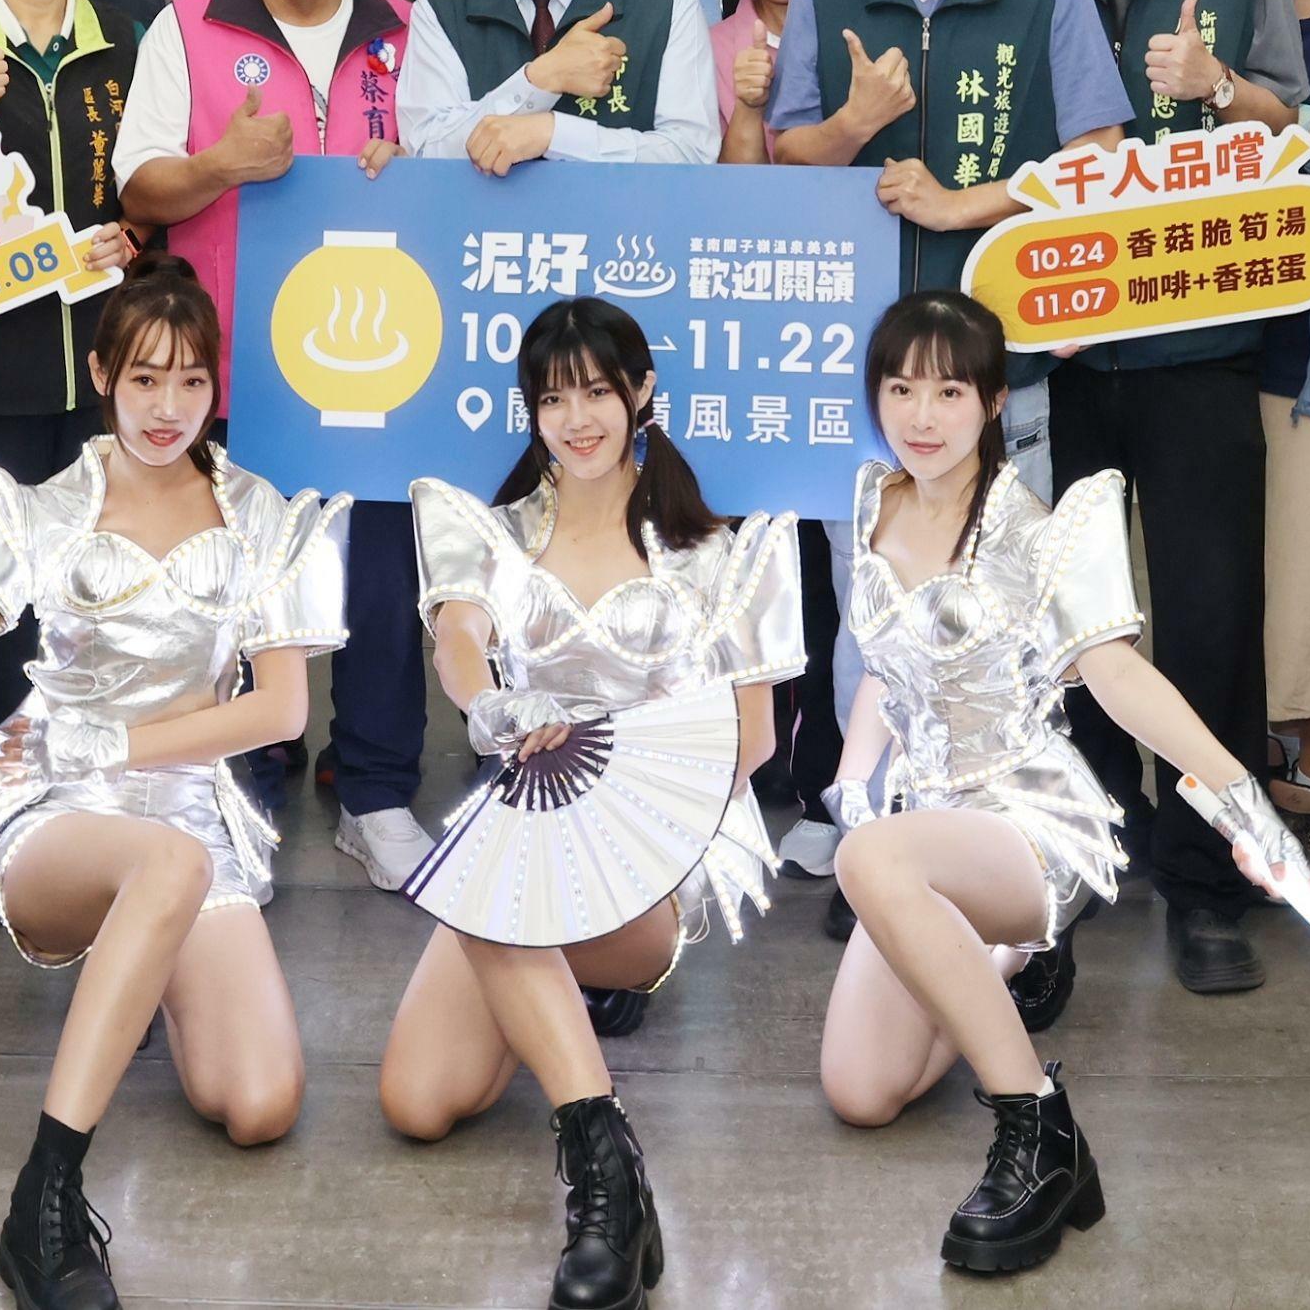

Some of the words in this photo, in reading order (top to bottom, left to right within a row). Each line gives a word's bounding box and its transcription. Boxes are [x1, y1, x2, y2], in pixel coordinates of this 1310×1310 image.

[105, 79, 124, 131] 白河
[359, 71, 389, 140] 蔡育
[953, 68, 990, 189] 林國華
[988, 42, 1017, 180] 觀光旅遊局局
[1055, 131, 1264, 205] 千人品嚐
[462, 231, 588, 295] 泥好
[604, 260, 666, 283] 2026
[690, 237, 854, 256] 臺南關子嶺溫泉美食節
[1029, 240, 1106, 273] 10.24
[1126, 206, 1306, 260] 香菇脆筍湯
[688, 257, 855, 303] 歡迎關嶺
[1034, 287, 1106, 318] 11.07
[1128, 253, 1307, 305] 咖啡+香菇蛋
[688, 319, 855, 374] 11.22
